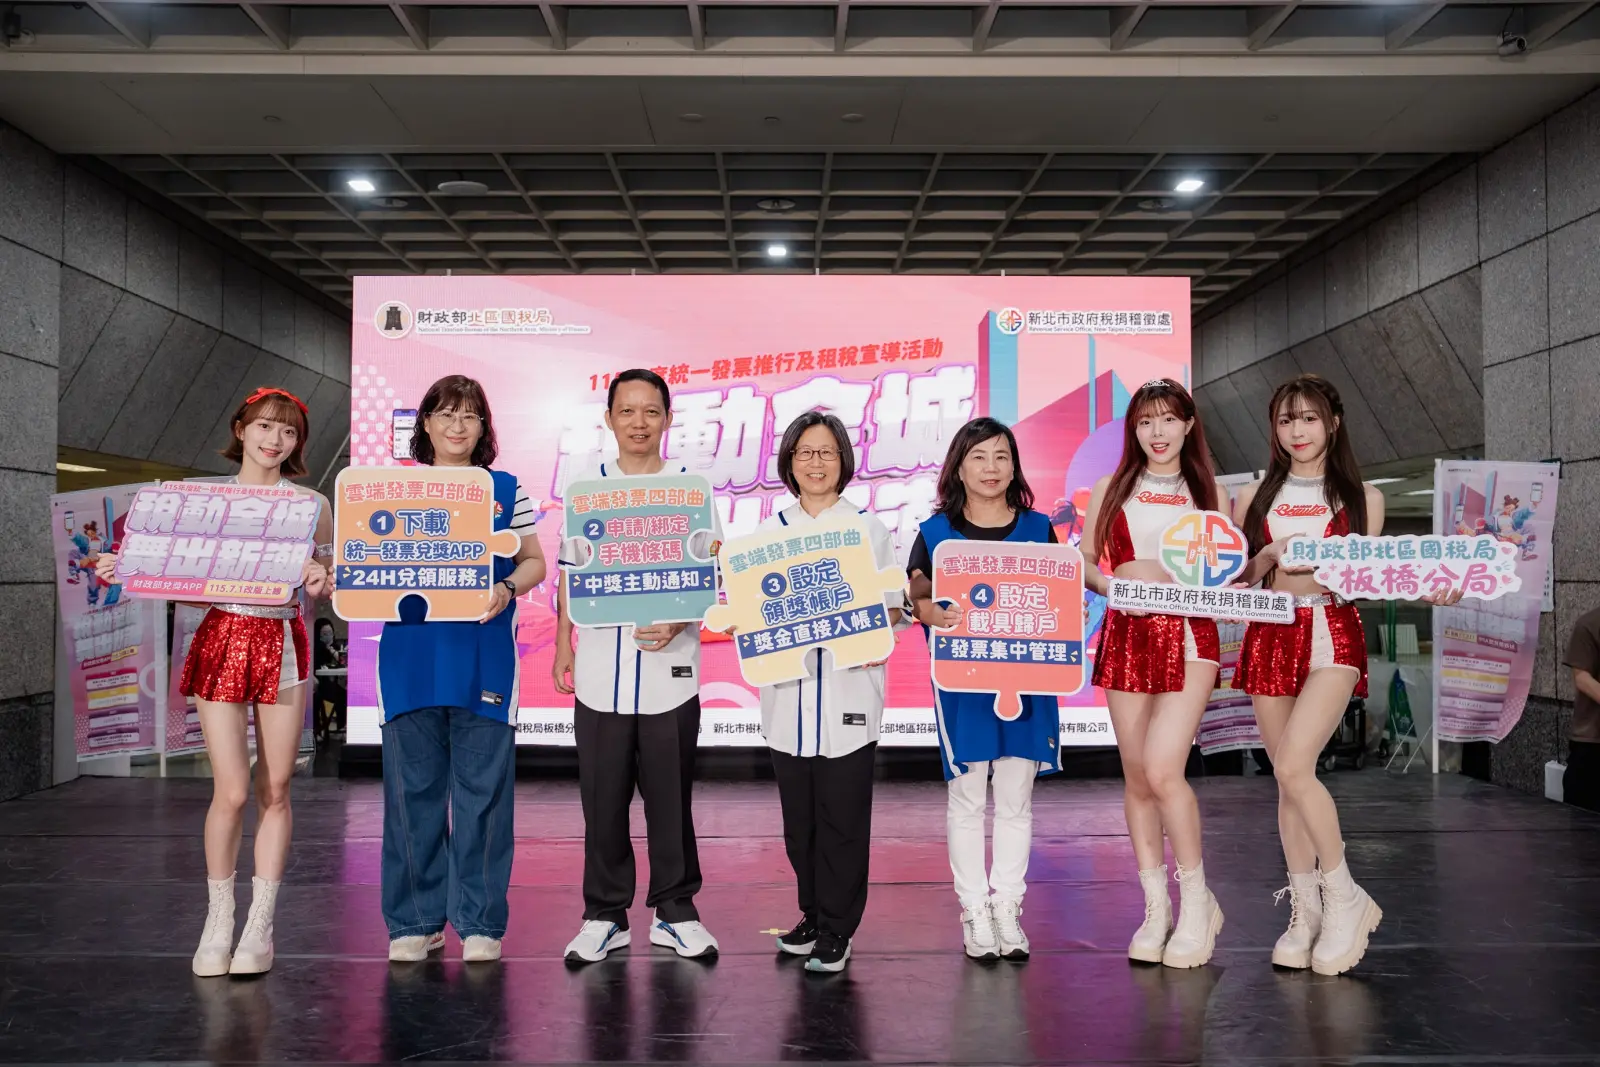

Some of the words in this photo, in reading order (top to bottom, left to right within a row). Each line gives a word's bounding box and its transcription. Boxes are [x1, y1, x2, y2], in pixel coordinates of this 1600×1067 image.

[418, 310, 550, 324] 財政部北區國稅局
[1029, 312, 1170, 325] 新北市政府稅捐稽徵處
[1108, 326, 1124, 334] Taipei
[1125, 326, 1136, 334] City
[590, 337, 943, 391] 11度統一發票推行及租稅宣導活動
[346, 480, 485, 504] 雲端發票四部曲
[572, 488, 704, 514] 雲端發票四部曲
[397, 510, 449, 535] 下載
[607, 515, 688, 538] 申請/綁定
[345, 541, 485, 561] 統一發票兌獎APP
[600, 540, 683, 565] 手機條碼
[729, 529, 861, 573] 雲端發票四部曲
[1292, 539, 1497, 561] 財政部北區國稅局
[352, 568, 477, 587] 24H兌領服務
[789, 559, 842, 591] 設定
[943, 556, 1076, 580] 雲端發票四部曲
[1339, 563, 1497, 595] 板橋分局
[585, 571, 699, 594] 中獎主動通知
[763, 585, 853, 625] 領獎帳戶
[998, 583, 1048, 609] 設定
[1114, 583, 1287, 611] 新北市政府稅捐稽徵處
[1114, 599, 1142, 607] Revenue
[1169, 604, 1191, 612] Office,
[1210, 607, 1229, 615] Taipei
[1245, 610, 1288, 619] Government
[754, 609, 871, 653] 獎金直接入帳
[968, 610, 1057, 636] 載具歸戶
[951, 639, 1067, 662] 發票集中管理
